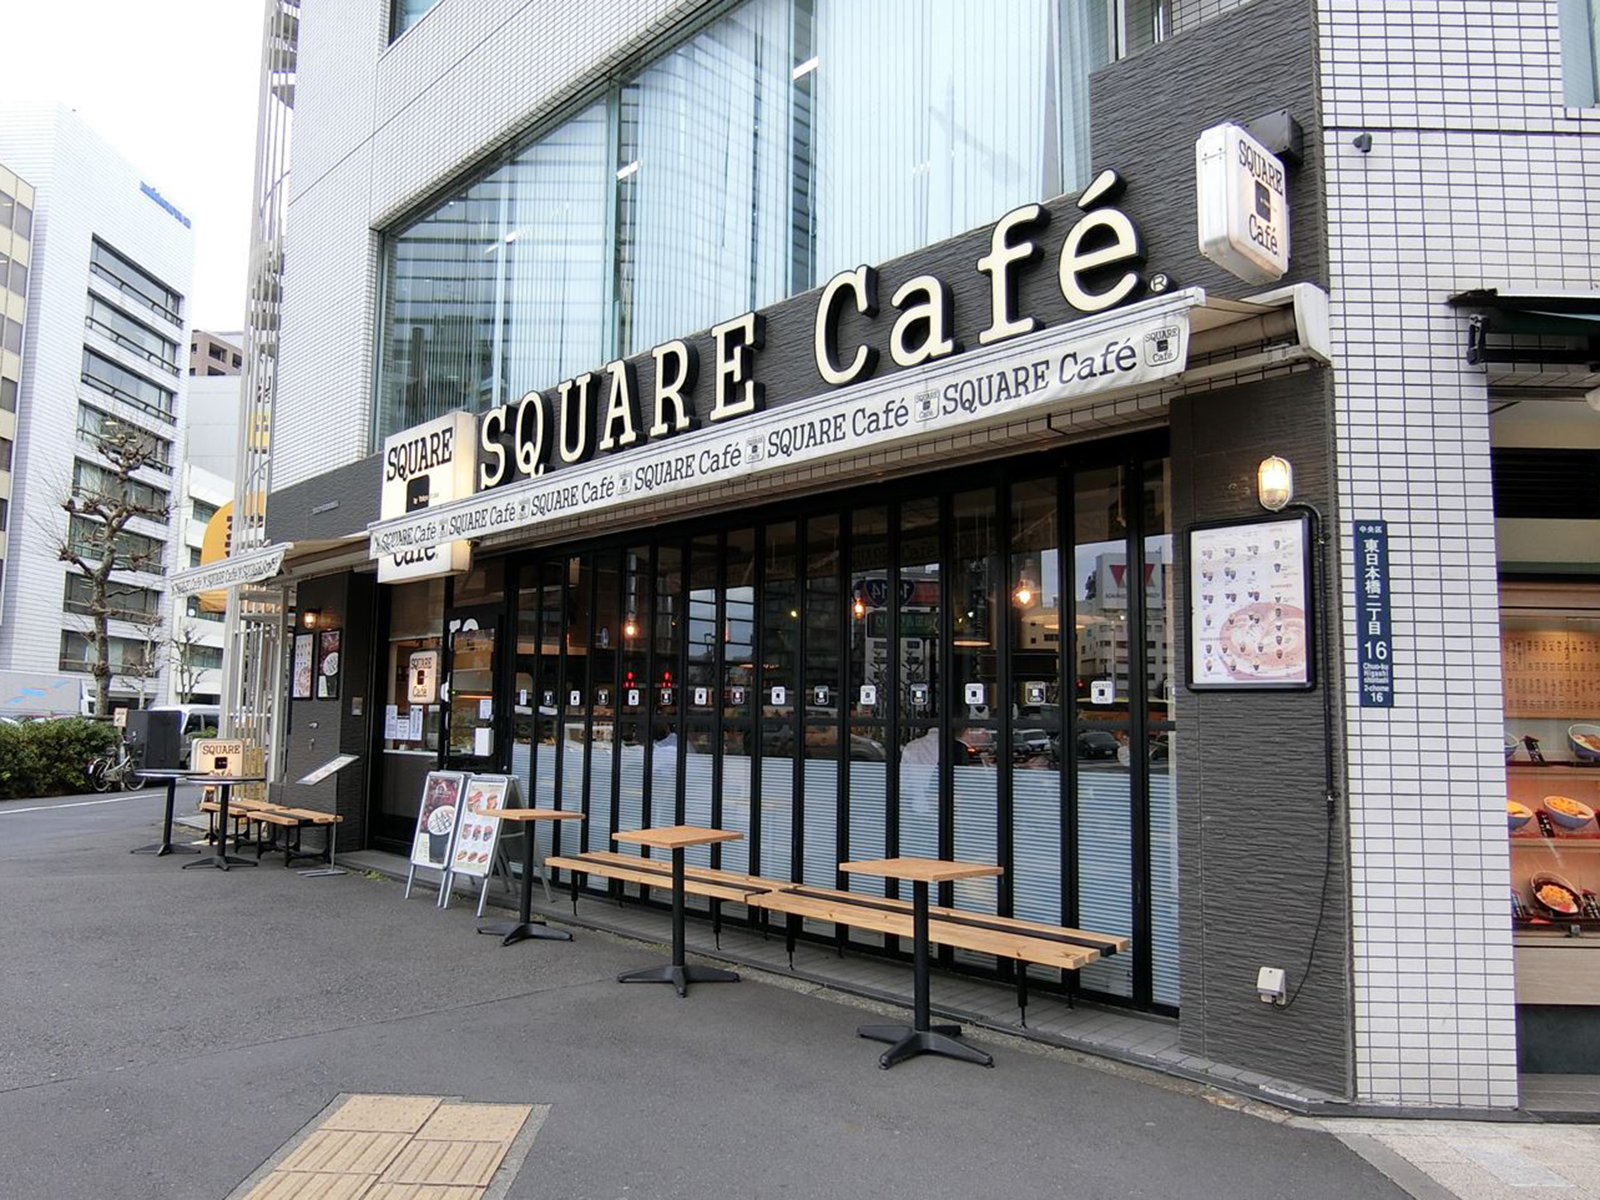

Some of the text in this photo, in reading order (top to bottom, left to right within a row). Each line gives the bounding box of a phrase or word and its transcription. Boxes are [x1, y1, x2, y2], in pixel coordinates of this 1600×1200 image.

[1238, 139, 1283, 196] SQUARE
[1249, 213, 1278, 255] Café
[480, 312, 760, 490] SQUARE
[813, 168, 1142, 386] Café
[386, 426, 454, 482] SQUARE
[449, 508, 488, 535] SQUARE
[489, 501, 516, 526] Café
[531, 485, 579, 516] SQUARE
[581, 475, 614, 504] Café
[634, 454, 695, 491] SQUARE
[699, 442, 742, 475] Café
[767, 414, 846, 458] SQUARE
[852, 398, 909, 437] Café
[942, 360, 1050, 416] SQUARE
[1058, 337, 1137, 385] Café
[1363, 538, 1381, 635] 東日本橋二丁目
[1364, 641, 1387, 660] 16
[1371, 692, 1384, 703] 16
[202, 744, 241, 756] SQUARE
